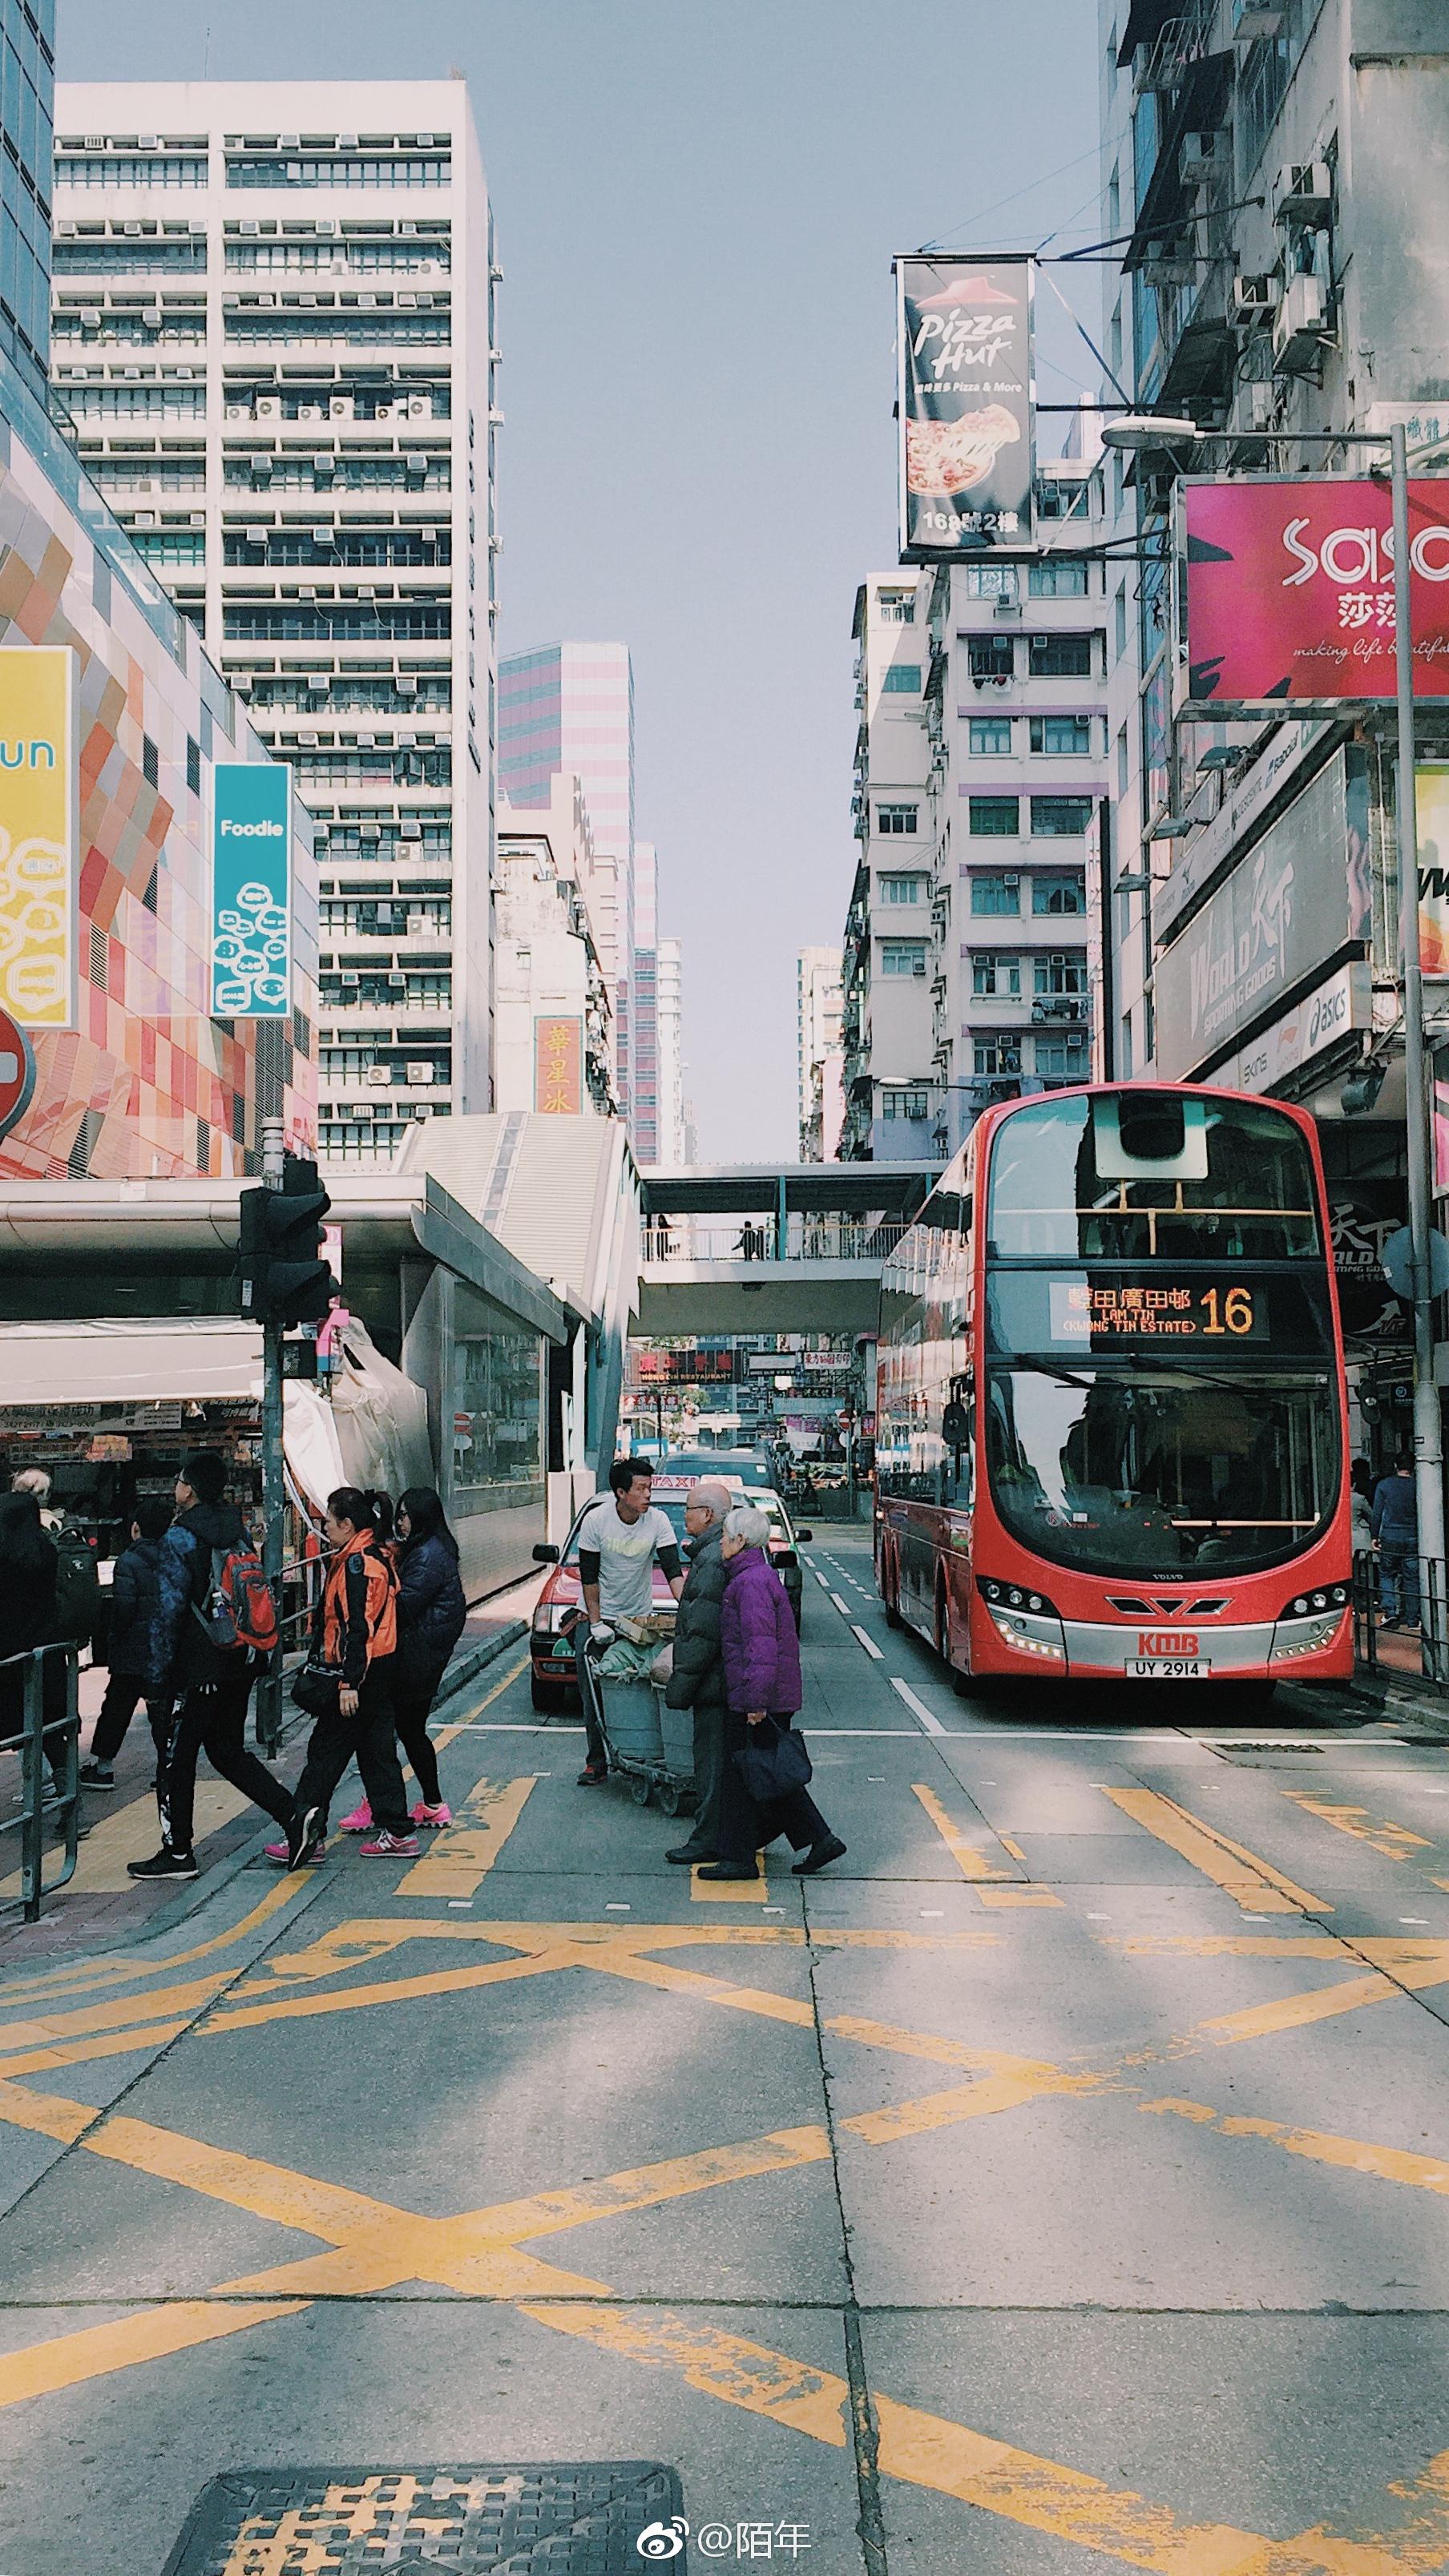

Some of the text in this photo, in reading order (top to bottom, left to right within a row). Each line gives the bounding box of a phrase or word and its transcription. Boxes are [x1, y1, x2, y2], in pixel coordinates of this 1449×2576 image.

[914, 308, 1017, 357] Pizza
[931, 337, 1009, 379] Hut
[953, 381, 980, 392] Pizza
[983, 382, 991, 392] &
[993, 381, 1023, 392] More
[1294, 639, 1348, 664] making
[1353, 638, 1383, 663] life
[220, 819, 284, 838] Foodie
[544, 1025, 572, 1113] 華星冰
[1102, 1309, 1155, 1320] LAM TIN
[1201, 1288, 1253, 1333] 16
[1113, 1320, 1136, 1332] TIN
[1140, 1320, 1196, 1333] ESTATE)
[652, 1476, 696, 1488] TAXI
[1138, 1633, 1199, 1656] KMB
[1136, 1662, 1199, 1676] UY 2914
